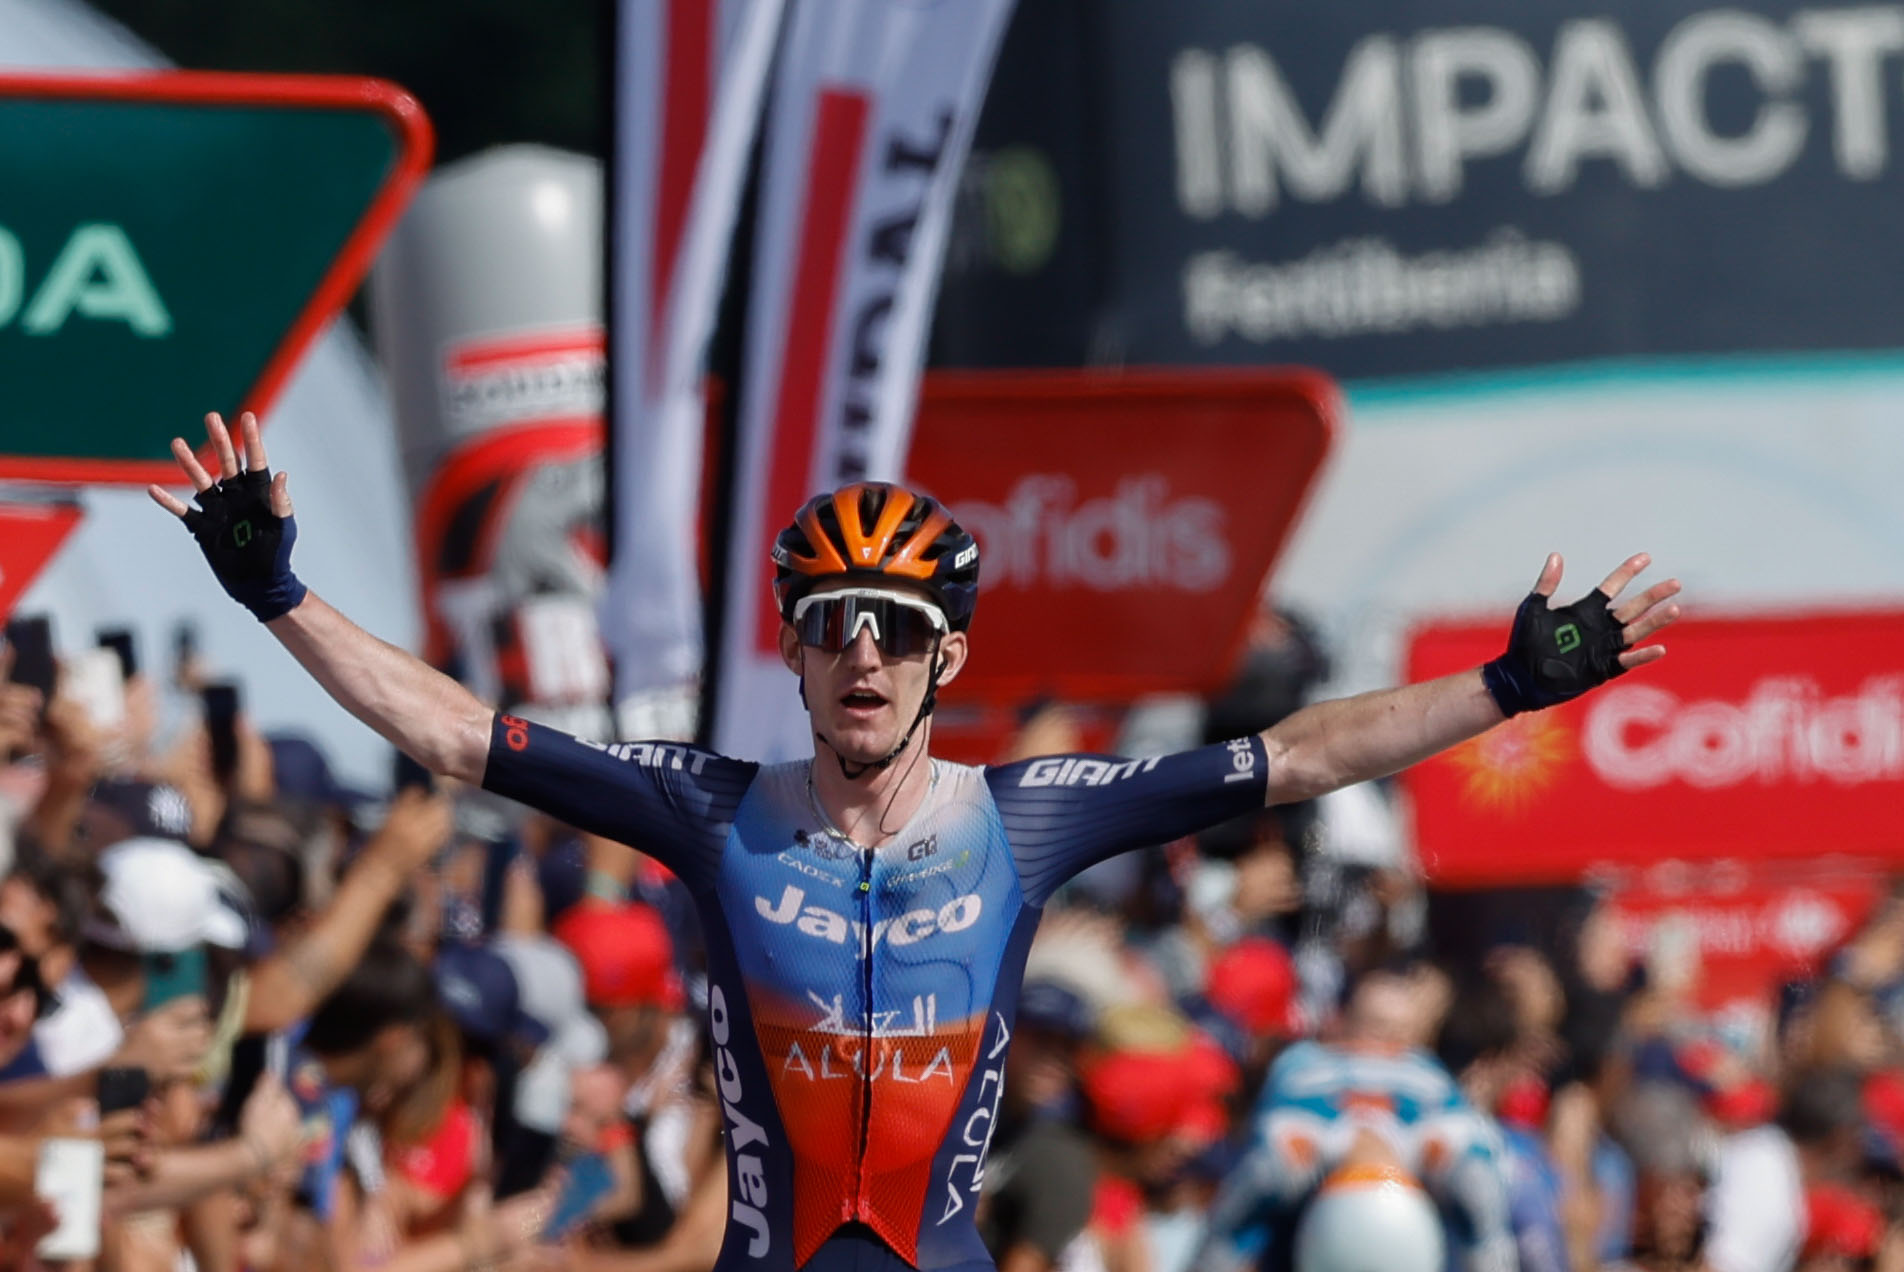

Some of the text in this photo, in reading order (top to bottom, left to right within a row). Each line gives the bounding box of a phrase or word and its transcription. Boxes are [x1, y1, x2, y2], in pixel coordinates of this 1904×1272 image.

[938, 473, 1234, 597] ofidis
[1018, 753, 1166, 788] GIANT
[778, 852, 846, 888] CADEX
[754, 884, 983, 960] Jayco
[781, 1041, 955, 1088] ALULA
[710, 984, 771, 1259] Jayco
